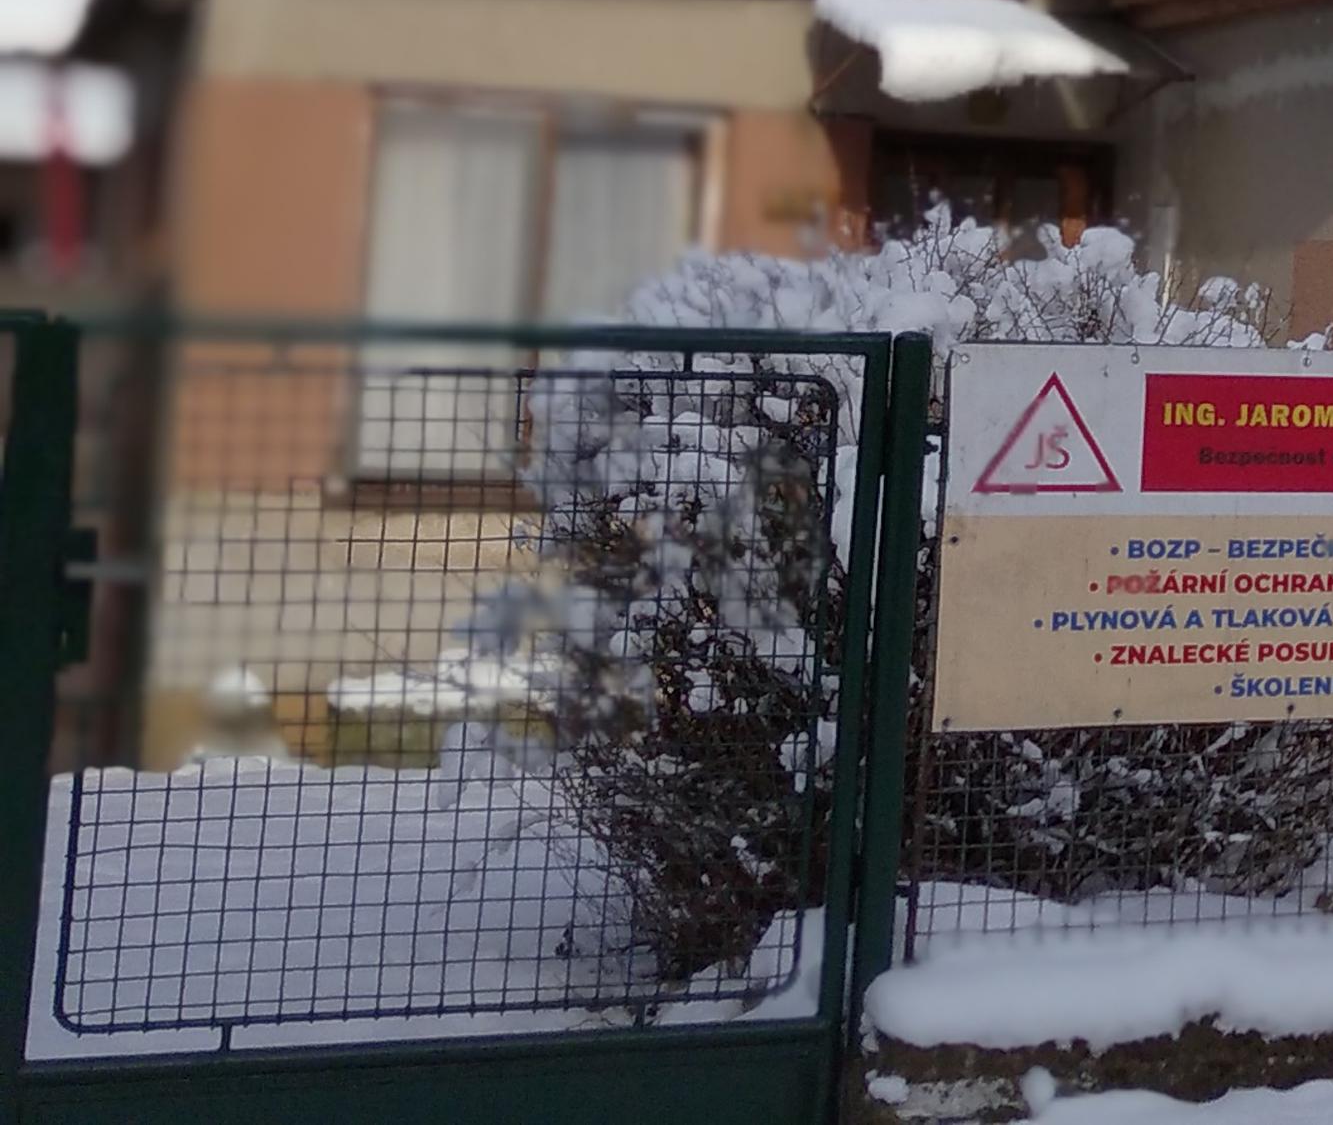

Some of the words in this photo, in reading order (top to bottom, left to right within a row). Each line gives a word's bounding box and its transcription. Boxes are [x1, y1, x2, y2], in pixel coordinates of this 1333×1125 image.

[1163, 403, 1225, 426] ING.
[1024, 426, 1070, 469] JŠ
[1127, 539, 1200, 559] BOZP
[1106, 569, 1229, 594] POŽÁRNÍ
[1052, 605, 1177, 631] PLYNOVÁ
[1184, 610, 1204, 628] A
[1212, 602, 1333, 627] TLAKOVÁ
[1110, 638, 1249, 665] ZNALECKÉ
